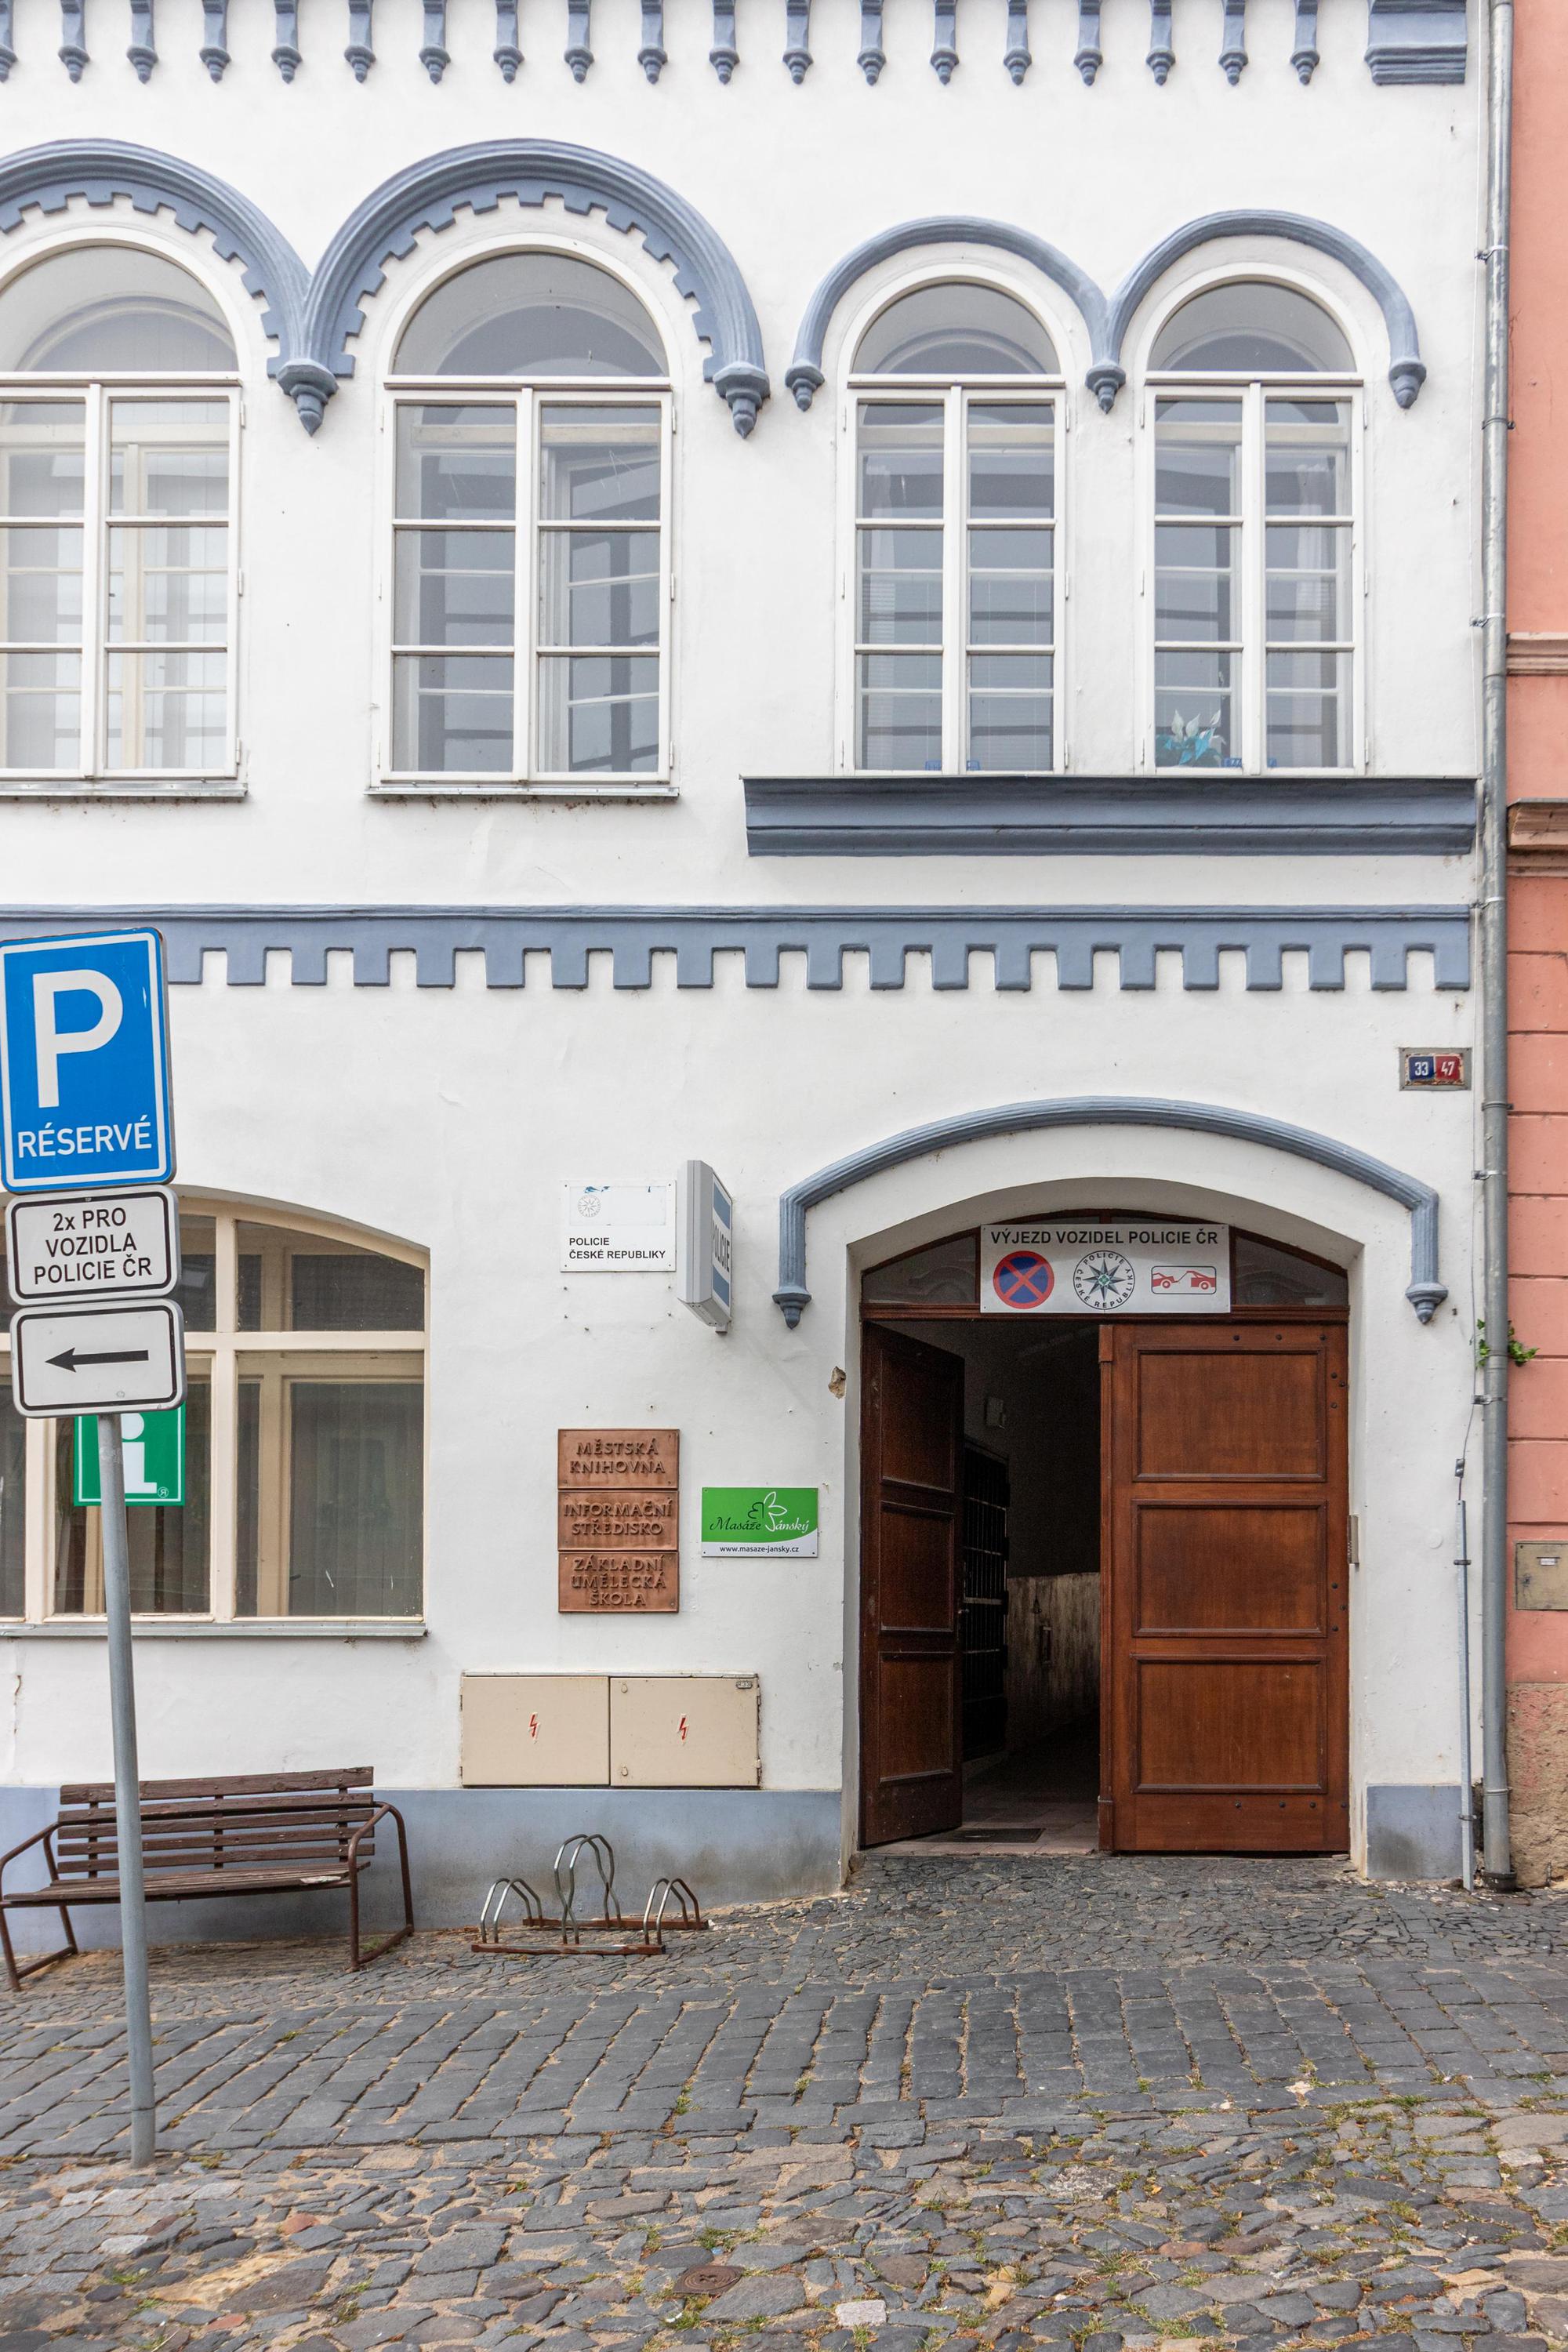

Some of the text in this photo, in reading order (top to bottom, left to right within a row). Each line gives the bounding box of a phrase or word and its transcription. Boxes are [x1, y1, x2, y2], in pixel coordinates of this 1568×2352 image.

[32, 969, 124, 1109] P
[1414, 1062, 1428, 1076] 33
[1441, 1061, 1455, 1076] 47
[17, 1114, 152, 1159] RÉSERVÉ
[53, 1207, 126, 1232] 2x PRO
[569, 1237, 610, 1246] POLICIE
[990, 1228, 1218, 1244] VÝJEZD VOZIDEL POLICIE ČR
[45, 1232, 137, 1258] VOZIDLA
[569, 1249, 666, 1259] ČESKÉ REPUBLIKY
[1083, 1252, 1125, 1265] POLICIE
[34, 1254, 152, 1285] POLICIE ČR
[1094, 1268, 1134, 1308] REPUBLIKY
[576, 1438, 659, 1455] MĚSTSKÁ
[570, 1461, 665, 1474] KNIHOVNA
[564, 1500, 673, 1517] INFORMAČNÍ
[572, 1519, 663, 1536] STŘEDISKO
[710, 1513, 810, 1534] Masáže Jánský
[720, 1545, 800, 1554] www.masaze-jansky.cz
[573, 1555, 665, 1571] ZÁKLADNÍ
[571, 1573, 666, 1589] UMĚLECKÁ
[590, 1589, 646, 1606] ŠKOLA
